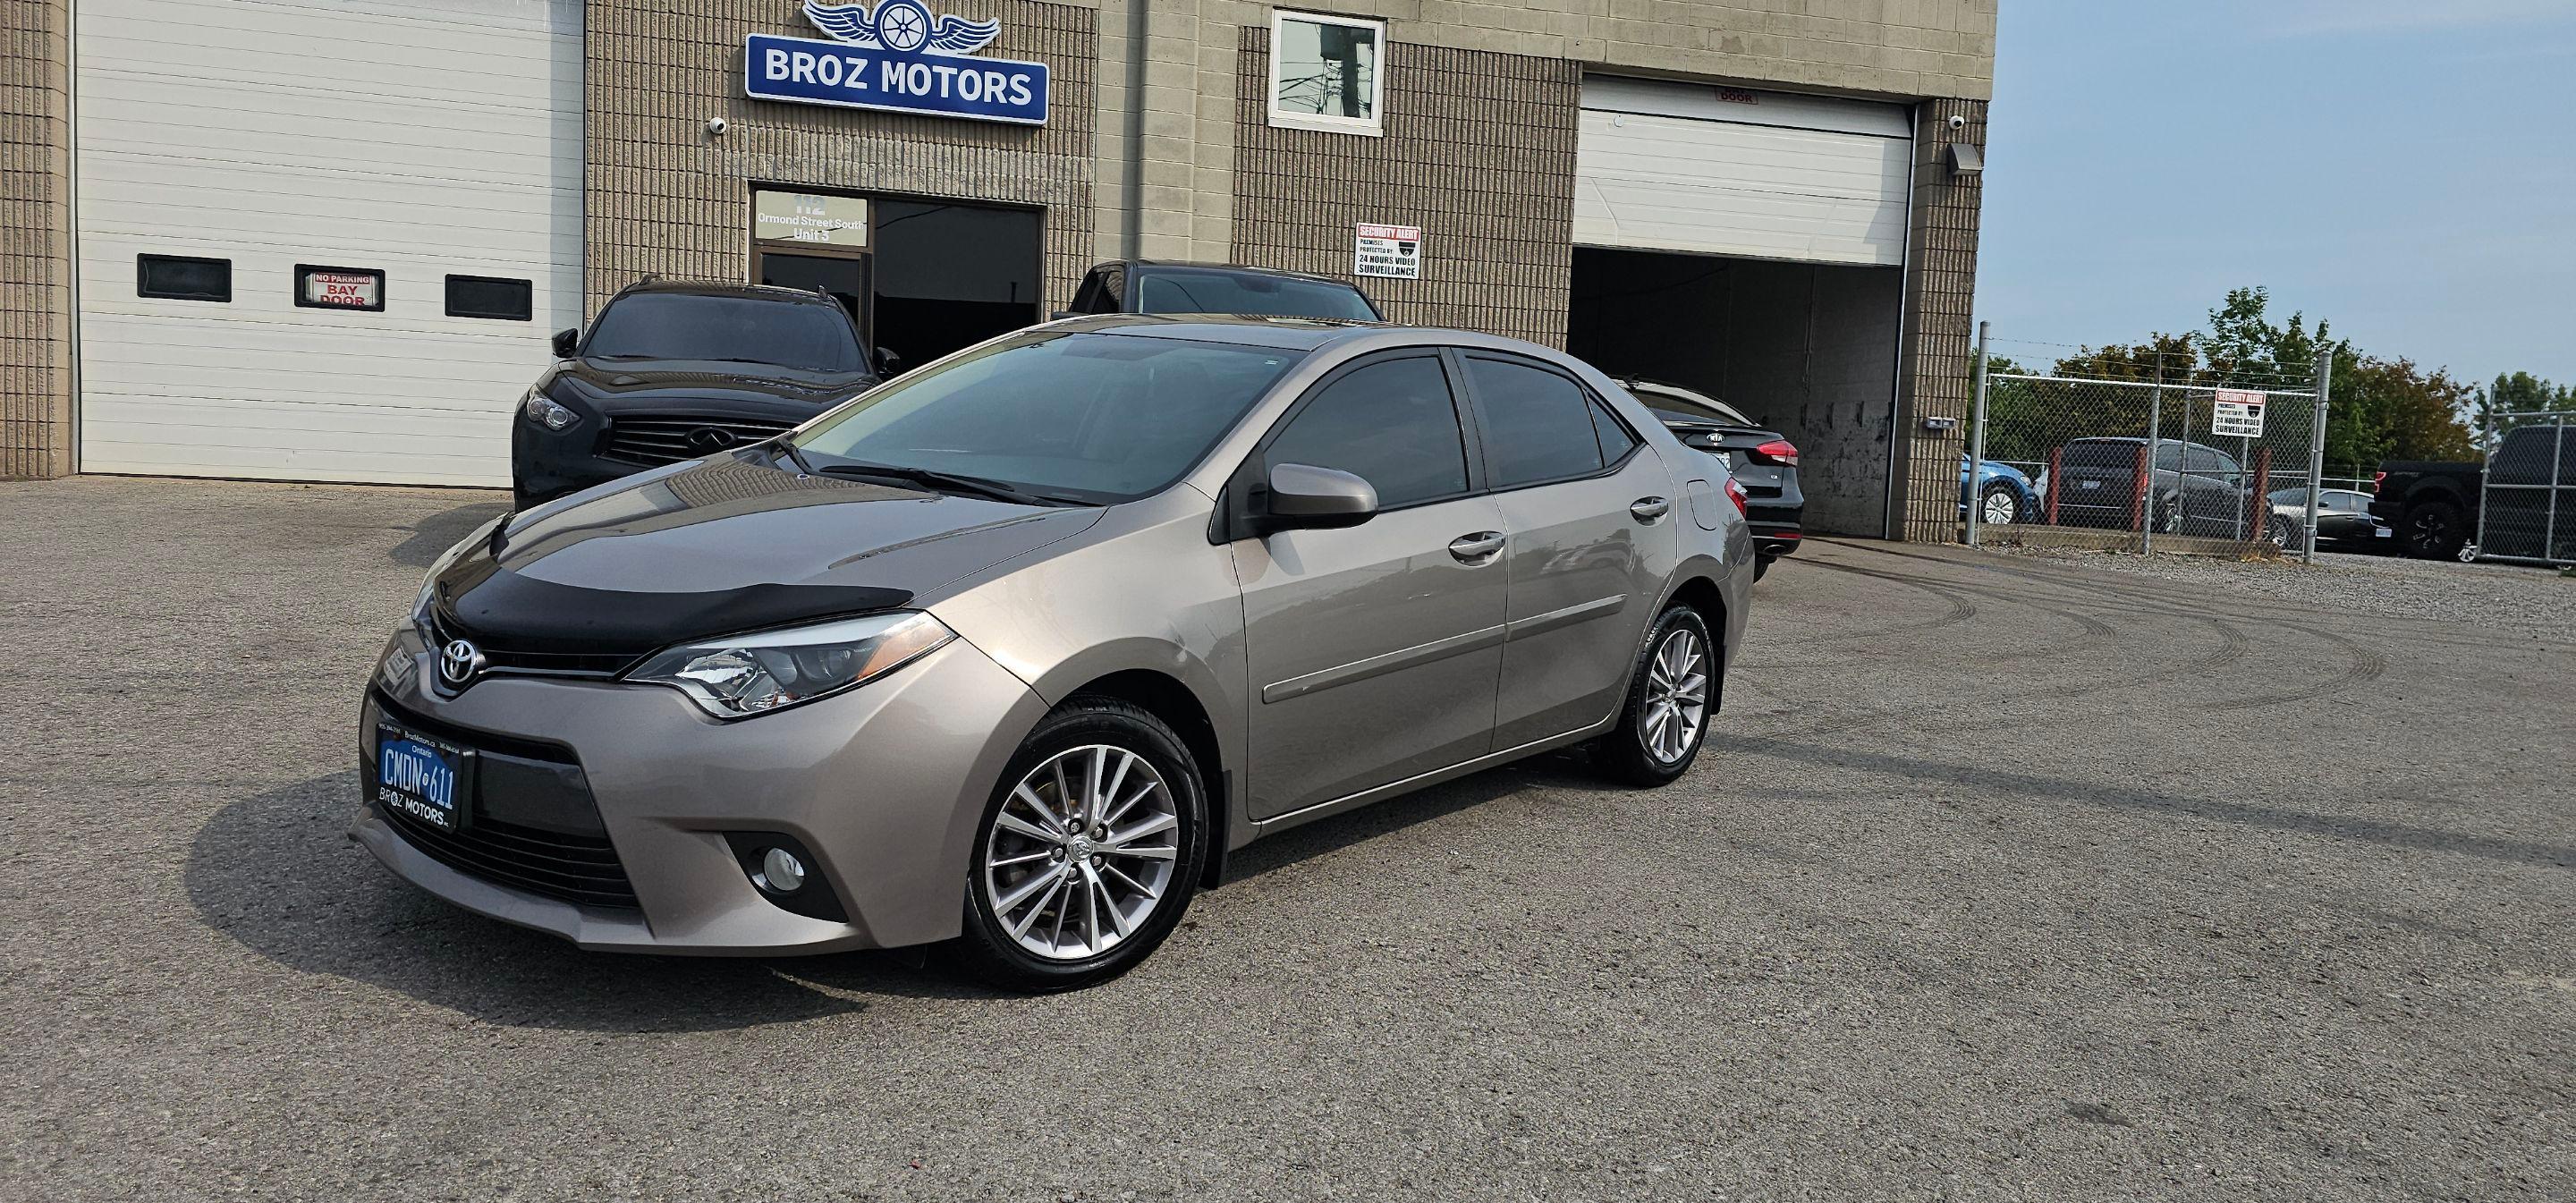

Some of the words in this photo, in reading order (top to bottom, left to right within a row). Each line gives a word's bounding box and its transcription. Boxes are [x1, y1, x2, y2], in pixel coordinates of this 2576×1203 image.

[766, 48, 869, 90] BROZ
[881, 60, 1032, 106] MOTORS
[1721, 92, 1753, 102] DOOR
[794, 194, 826, 216] 112
[758, 213, 800, 225] Ormond
[801, 216, 833, 227] Street
[835, 219, 867, 230] South
[793, 228, 819, 241] Unit
[1360, 225, 1395, 238] SECURITY
[1396, 229, 1419, 241] ALERT
[1360, 246, 1385, 254] PROTECTED
[1360, 254, 1368, 263] 24
[1369, 255, 1394, 265] HOURS
[1395, 257, 1416, 267] VIDEO
[1359, 264, 1416, 276] SURVEILLANCE
[316, 274, 329, 282] NO
[331, 275, 369, 284] PARKING
[327, 284, 358, 295] BAY
[320, 295, 365, 305] DOOR
[2218, 391, 2246, 402] SECURITY
[2246, 394, 2264, 404] ALERT
[2224, 417, 2242, 426] HOURS
[2243, 419, 2260, 427] VIDEO
[2216, 425, 2259, 436] SURVEILLANCE
[411, 745, 432, 758] Ontario
[385, 749, 423, 795] CMDN
[429, 765, 454, 810] 611
[405, 797, 445, 826] MOTORS
